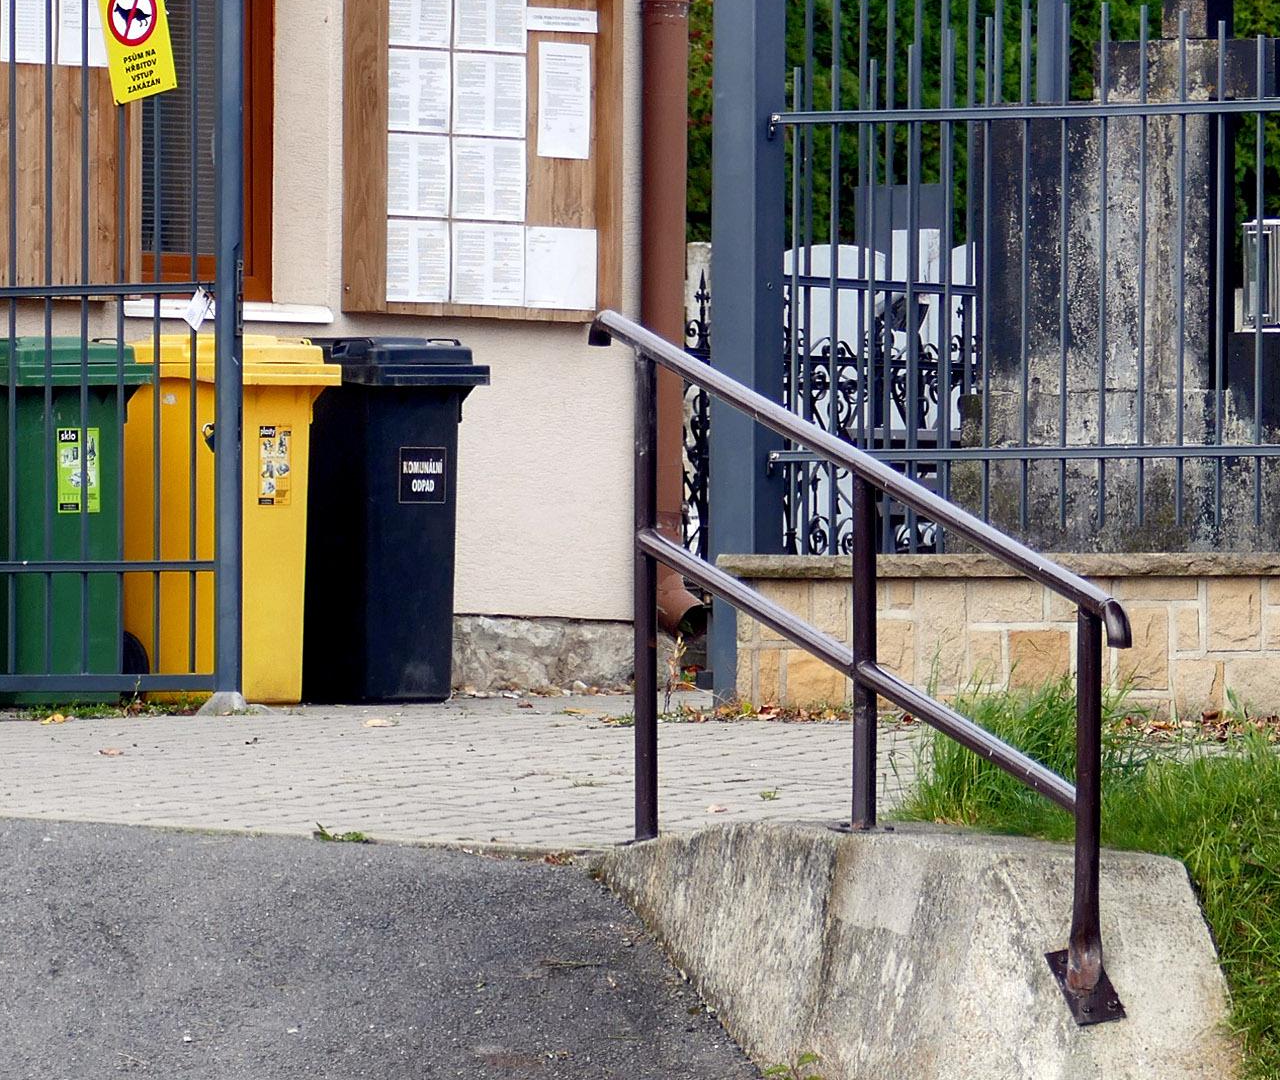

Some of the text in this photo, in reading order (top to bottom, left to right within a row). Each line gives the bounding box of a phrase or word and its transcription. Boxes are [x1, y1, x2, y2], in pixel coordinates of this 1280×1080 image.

[123, 48, 156, 64] PSŮM NA
[125, 58, 157, 74] HŘBITOV
[130, 69, 154, 82] VSTUP
[60, 430, 76, 440] sklo
[402, 458, 443, 474] KOMUNÁLNÍ
[411, 479, 435, 492] ODPAD
